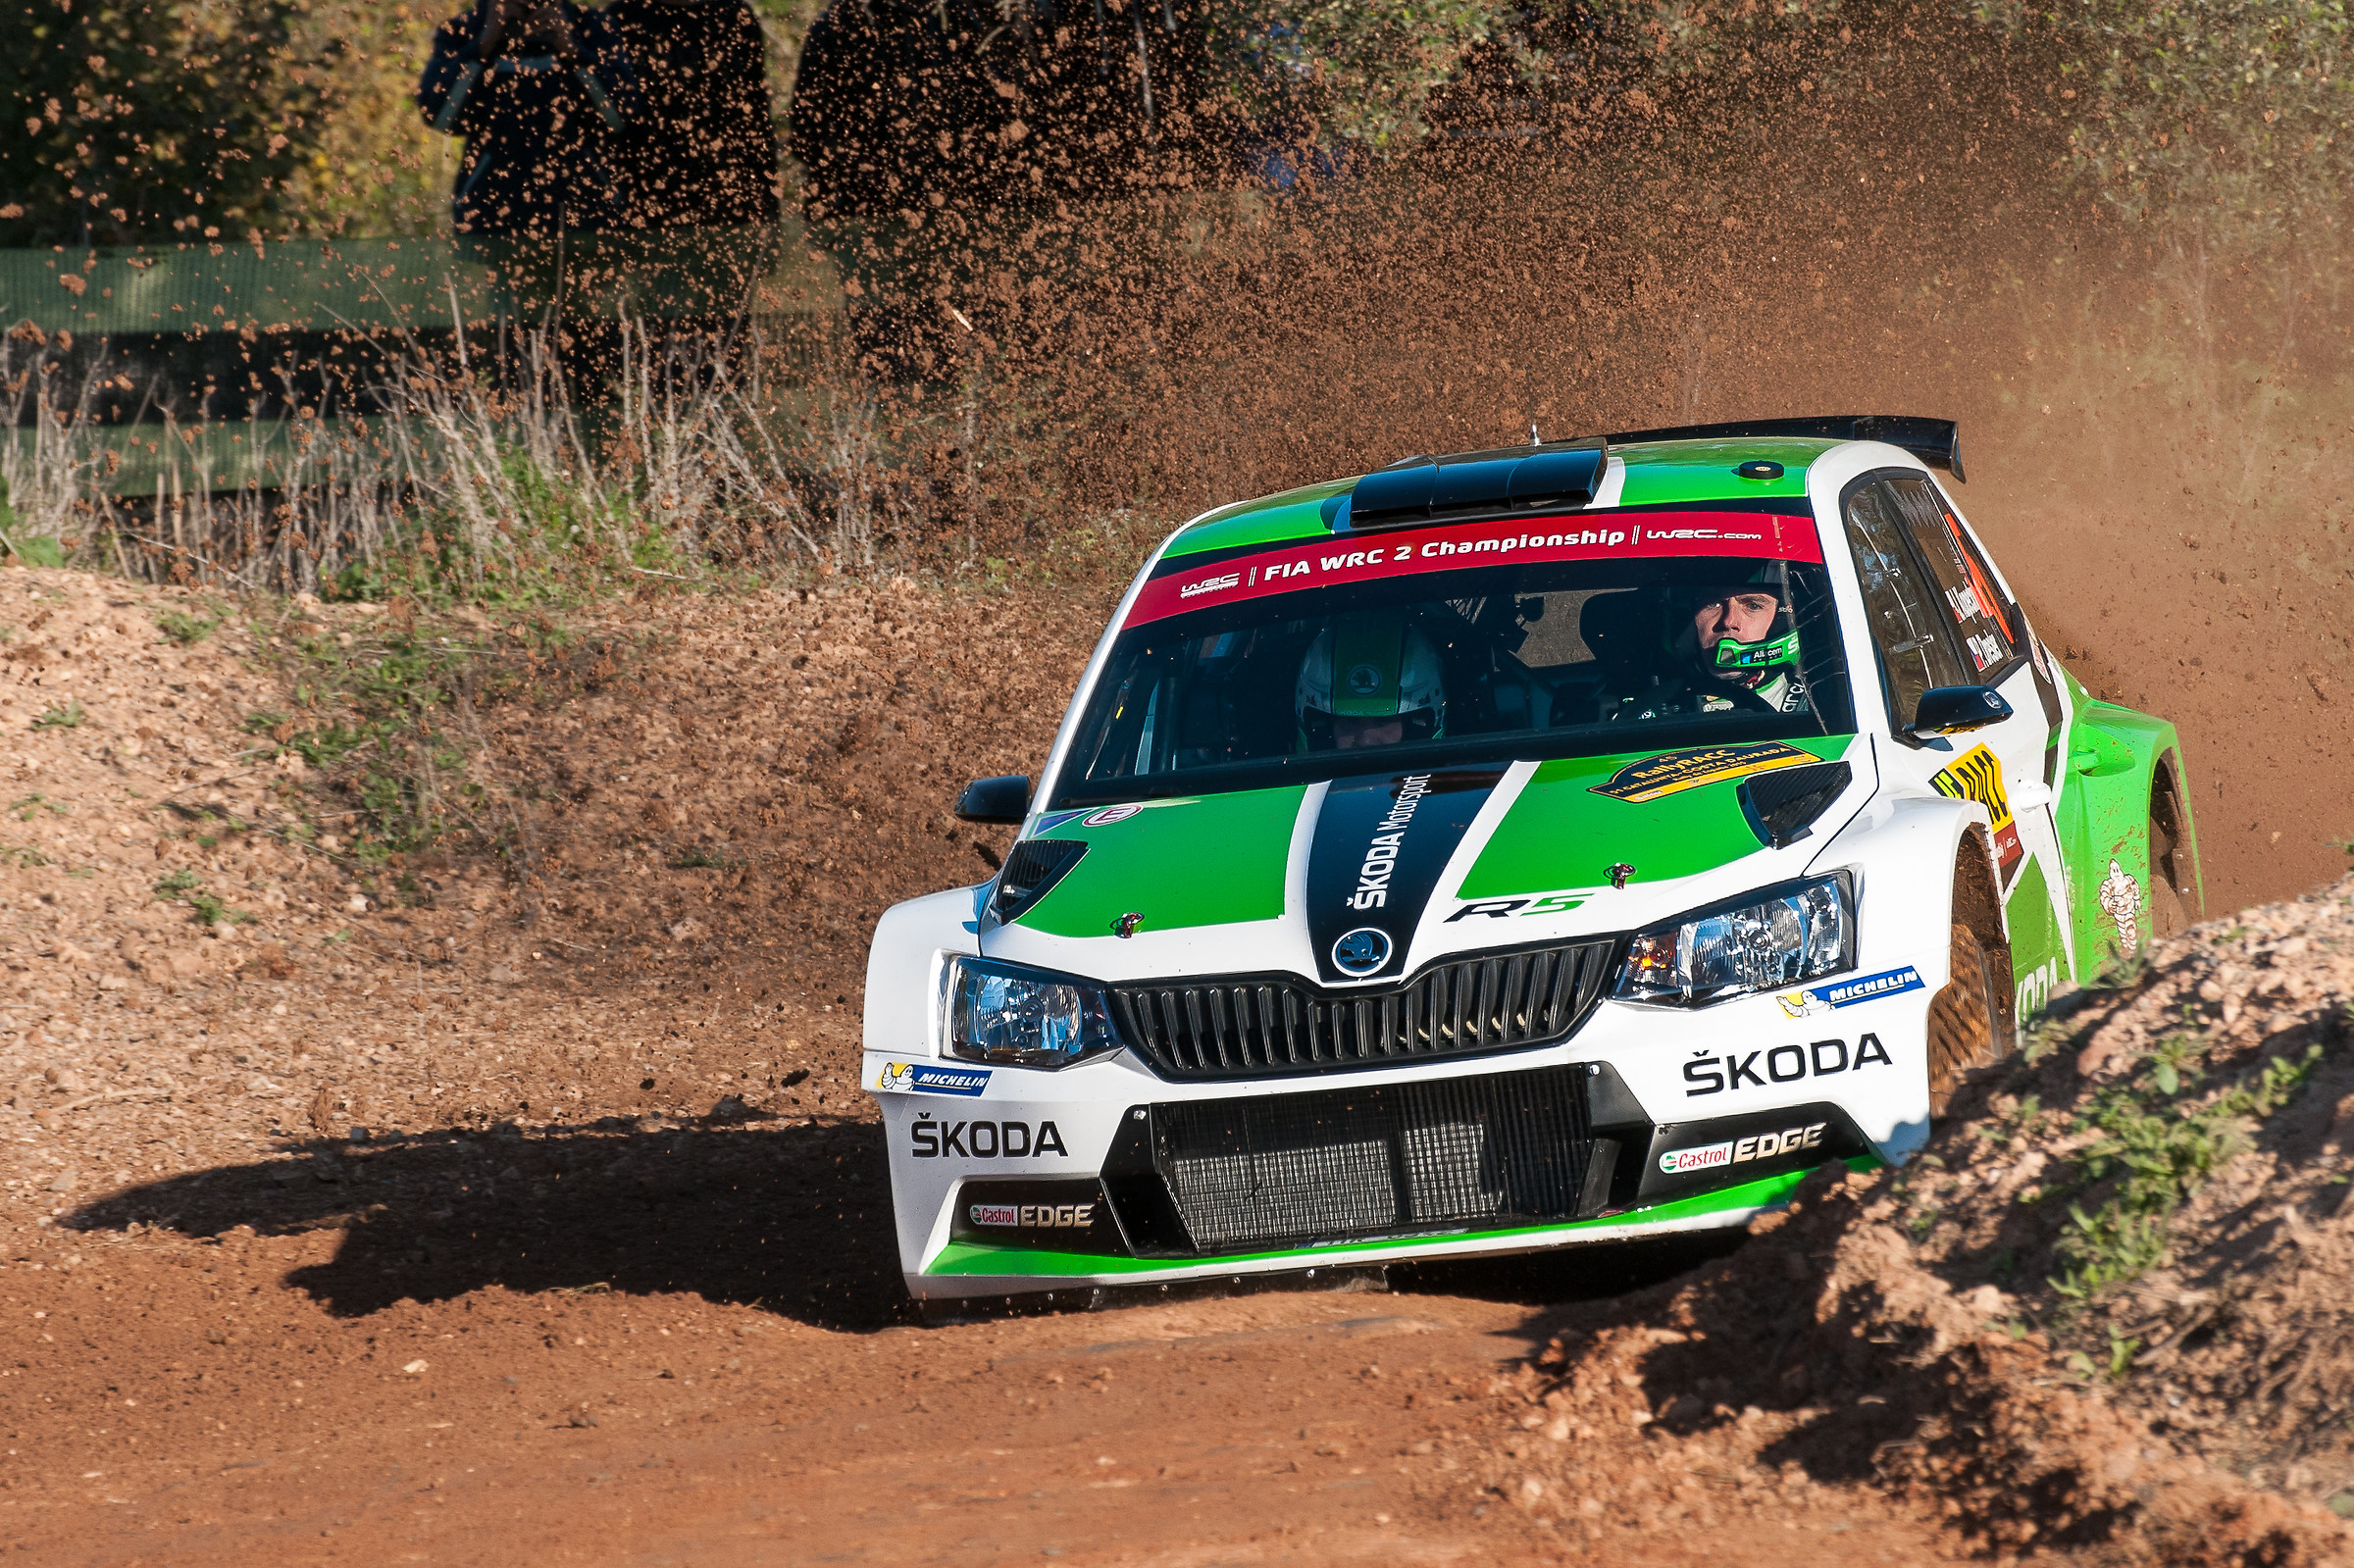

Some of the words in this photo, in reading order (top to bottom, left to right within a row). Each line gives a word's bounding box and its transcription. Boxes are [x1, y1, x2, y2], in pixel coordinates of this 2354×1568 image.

[1646, 529, 1763, 540] WRC.com
[1264, 560, 1311, 582] FIA
[1320, 548, 1383, 572] WRC
[1393, 545, 1412, 561] 2
[1421, 530, 1626, 558] Championship
[1630, 748, 1737, 780] RallyRACC
[1095, 807, 1125, 822] E
[1347, 832, 1405, 910] ŠKODA
[1376, 774, 1432, 832] Motorsport
[1443, 892, 1596, 923] R5
[1828, 970, 1919, 1003] MICHELIN
[917, 1072, 989, 1088] MICHELIN
[1682, 1032, 1893, 1097] ŠKODA
[910, 1112, 1069, 1159] ŠKODA
[1678, 1145, 1729, 1170] Castrol
[1732, 1122, 1827, 1164] EDGE
[981, 1206, 1016, 1226] Castrol
[1019, 1202, 1096, 1228] EDGE
